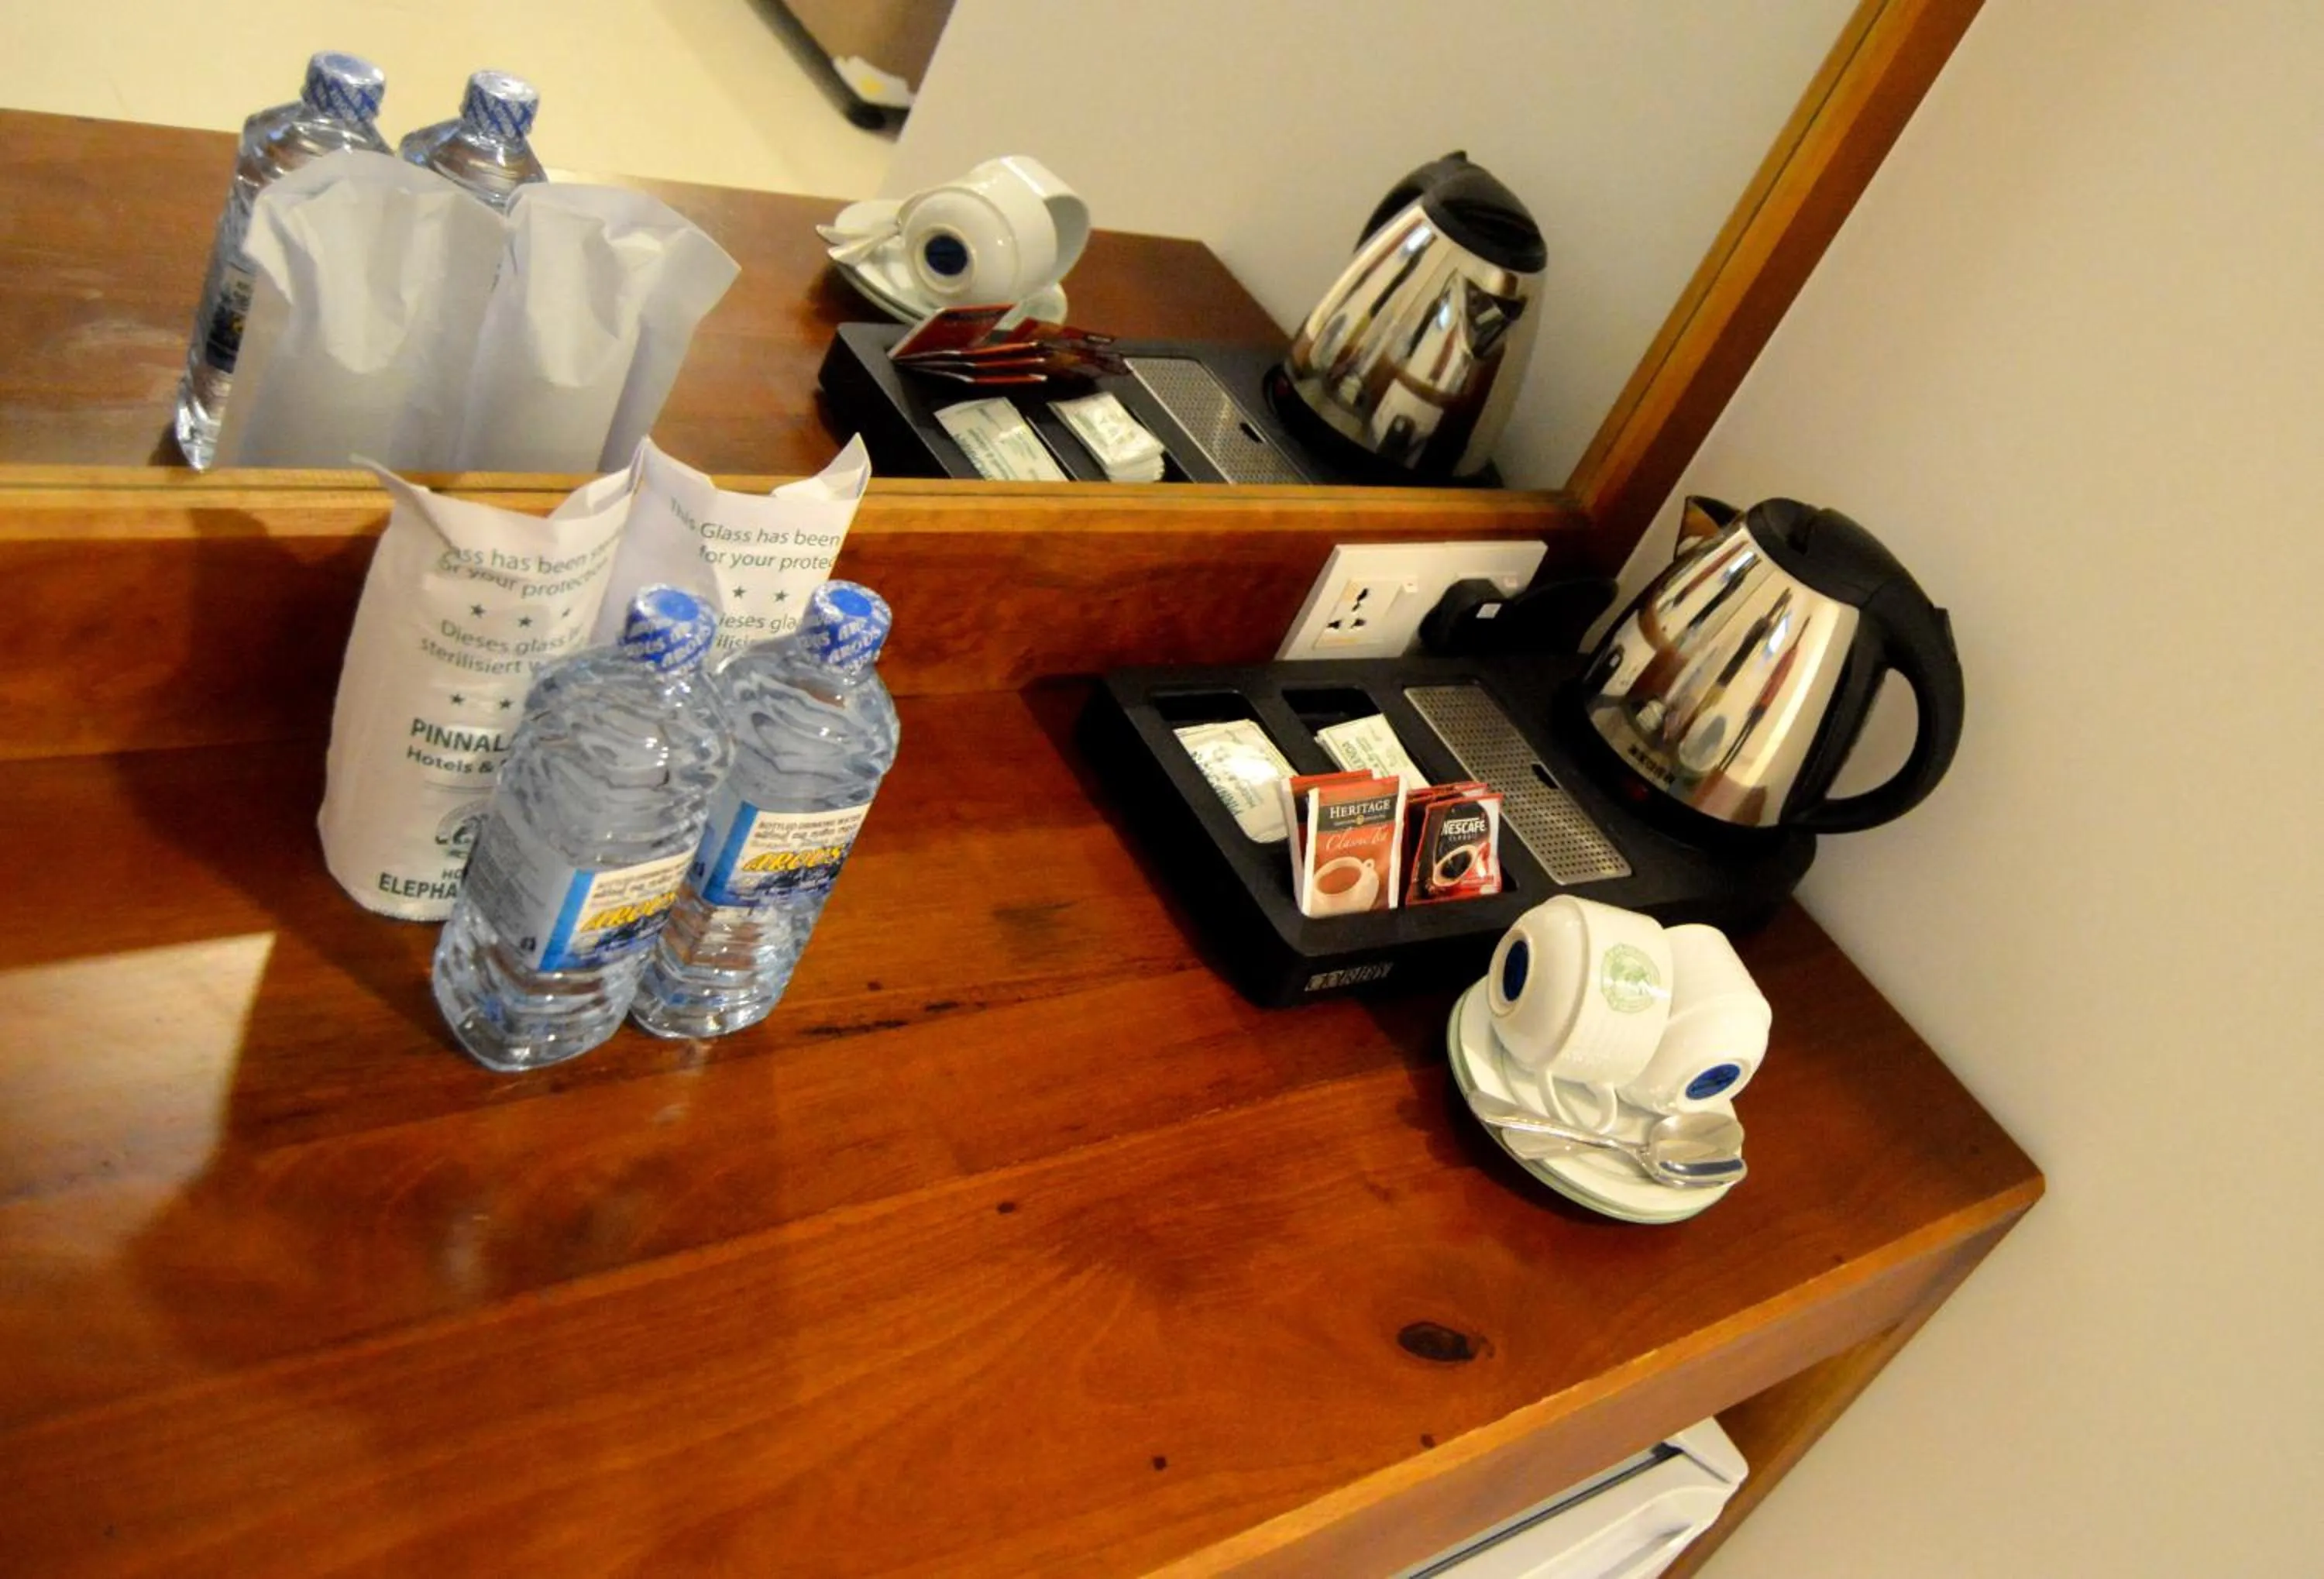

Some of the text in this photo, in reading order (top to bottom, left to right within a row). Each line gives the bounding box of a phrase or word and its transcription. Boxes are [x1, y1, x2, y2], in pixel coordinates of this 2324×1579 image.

[700, 522, 751, 542] Glass
[755, 528, 789, 545] has
[793, 528, 841, 546] been
[490, 547, 531, 572] has
[729, 552, 775, 569] your
[719, 613, 797, 634] ieses gla
[440, 619, 509, 655] Dieses
[421, 637, 521, 674] sterilisiert
[410, 717, 514, 753] PINNAL
[406, 745, 472, 773] Hotels
[1329, 799, 1391, 819] HERITAGE
[378, 872, 459, 900] ELEPHA
